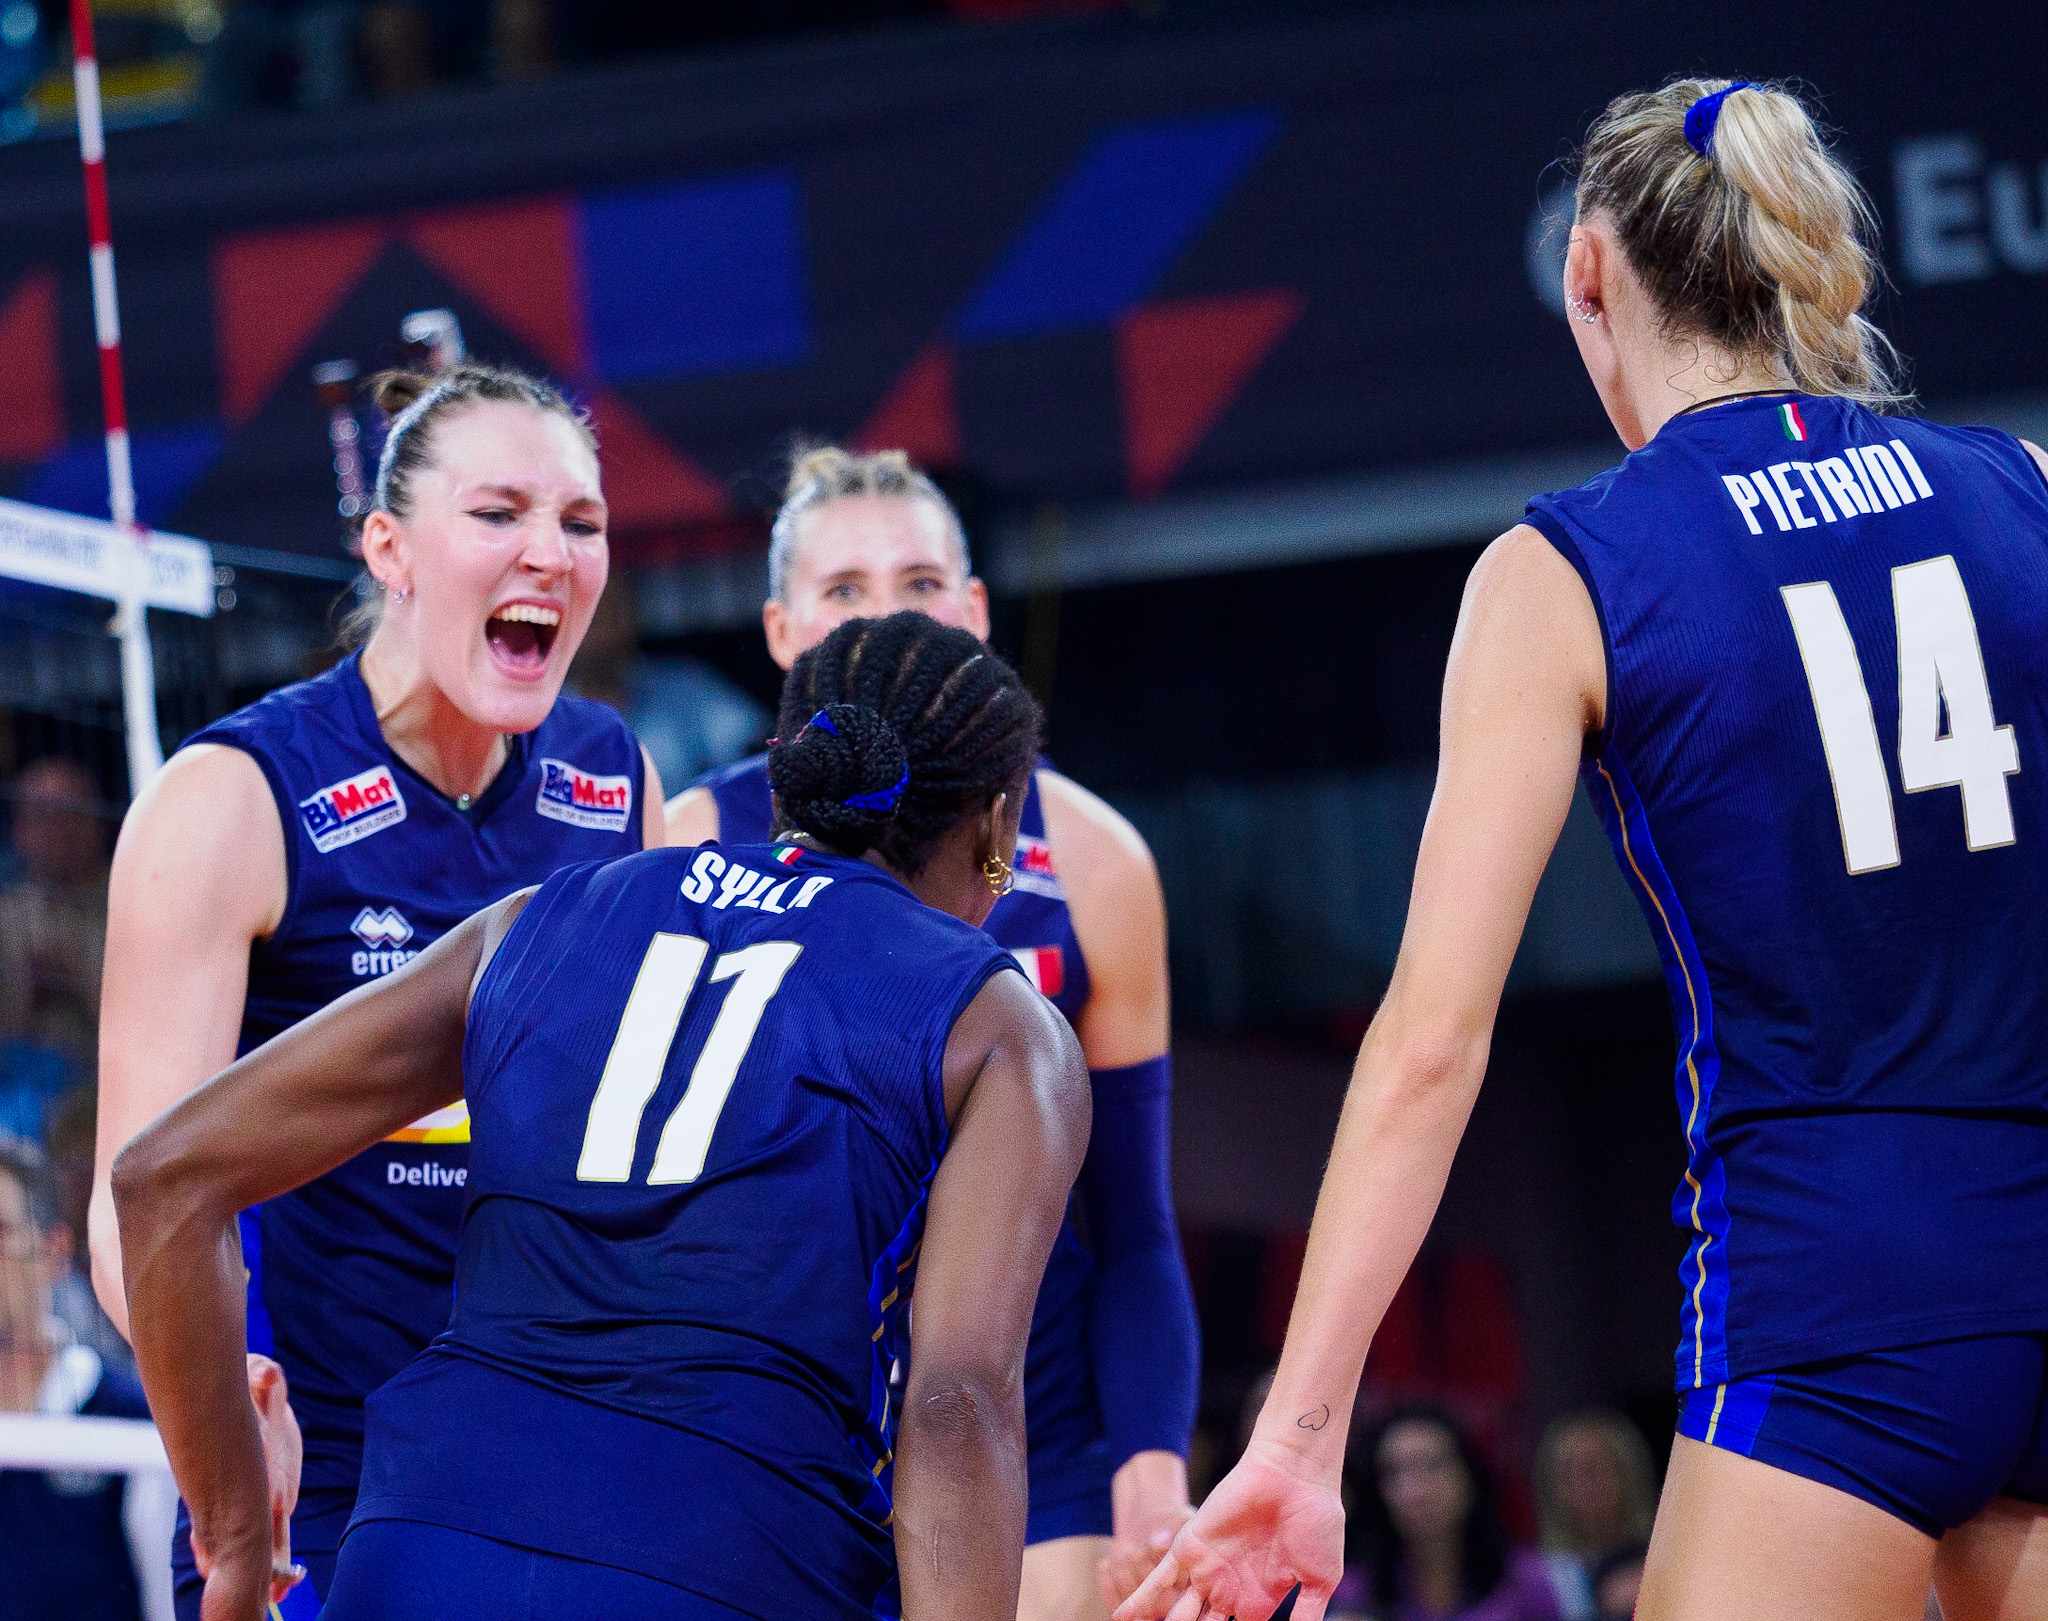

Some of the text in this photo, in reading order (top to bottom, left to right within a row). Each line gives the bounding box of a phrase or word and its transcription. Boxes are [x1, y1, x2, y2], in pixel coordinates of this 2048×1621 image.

[1720, 438, 1934, 536] PIETRINI
[1779, 554, 2021, 876] 14
[680, 850, 835, 915] SYLLA
[576, 931, 804, 1186] 11
